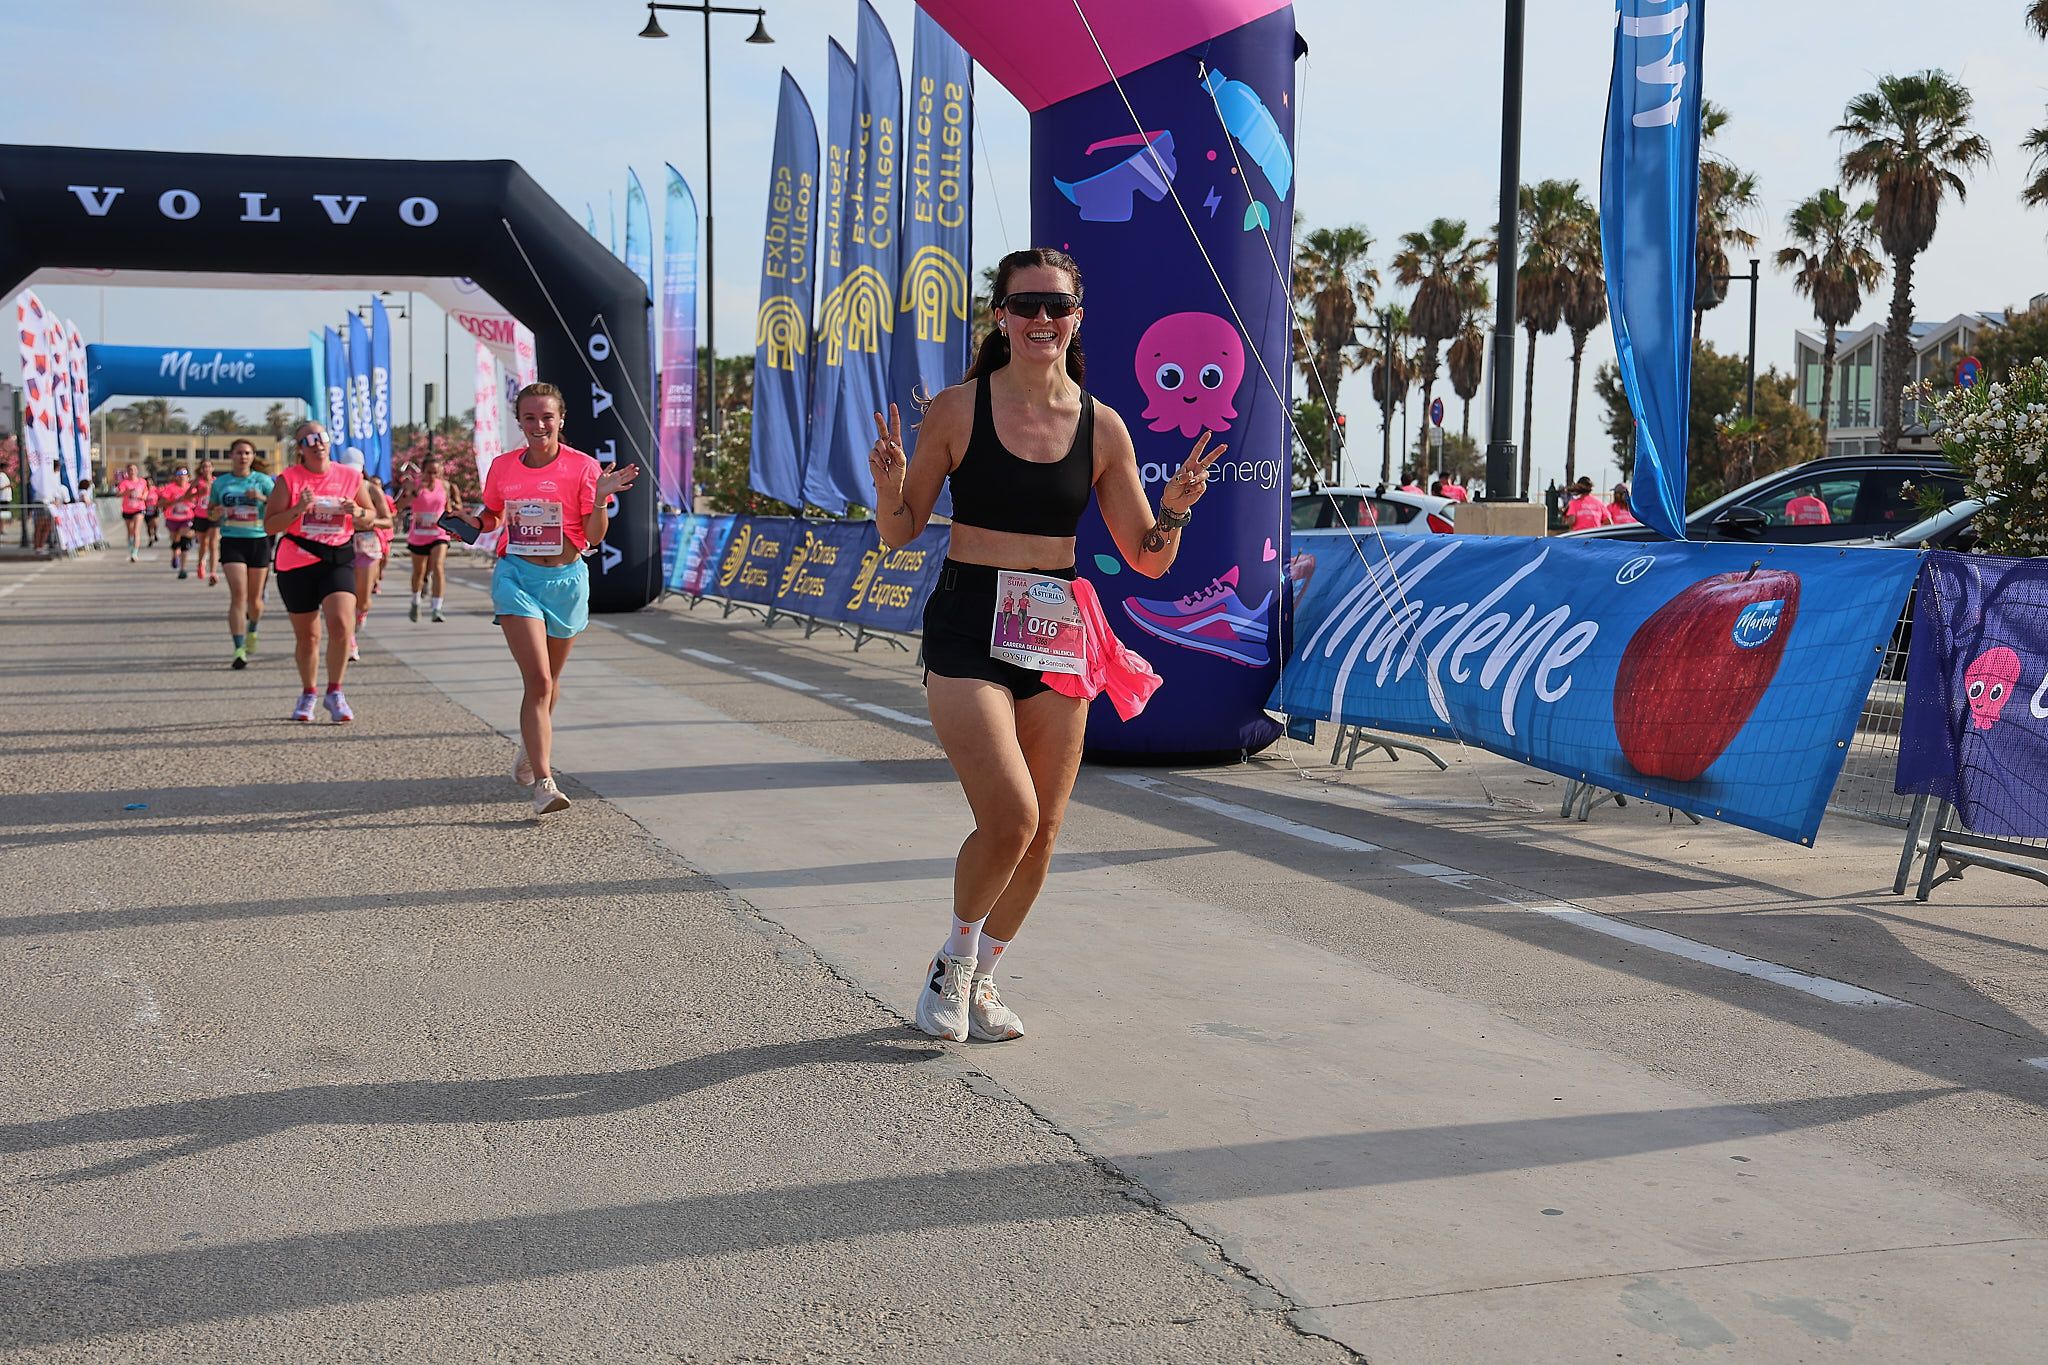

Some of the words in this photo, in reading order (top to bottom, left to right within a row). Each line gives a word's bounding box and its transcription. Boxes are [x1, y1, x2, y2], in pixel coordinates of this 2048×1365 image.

[67, 185, 439, 227] VOLVO
[458, 314, 514, 345] COSM
[160, 350, 256, 391] Marlene
[520, 526, 543, 536] 016
[868, 576, 913, 612] Express
[1028, 617, 1058, 637] 016
[1302, 540, 1599, 736] Marlene
[1736, 610, 1778, 637] Marlene
[1002, 640, 1026, 650] CARRERA
[1052, 649, 1075, 657] VALENCIA
[1045, 660, 1075, 668] Santander
